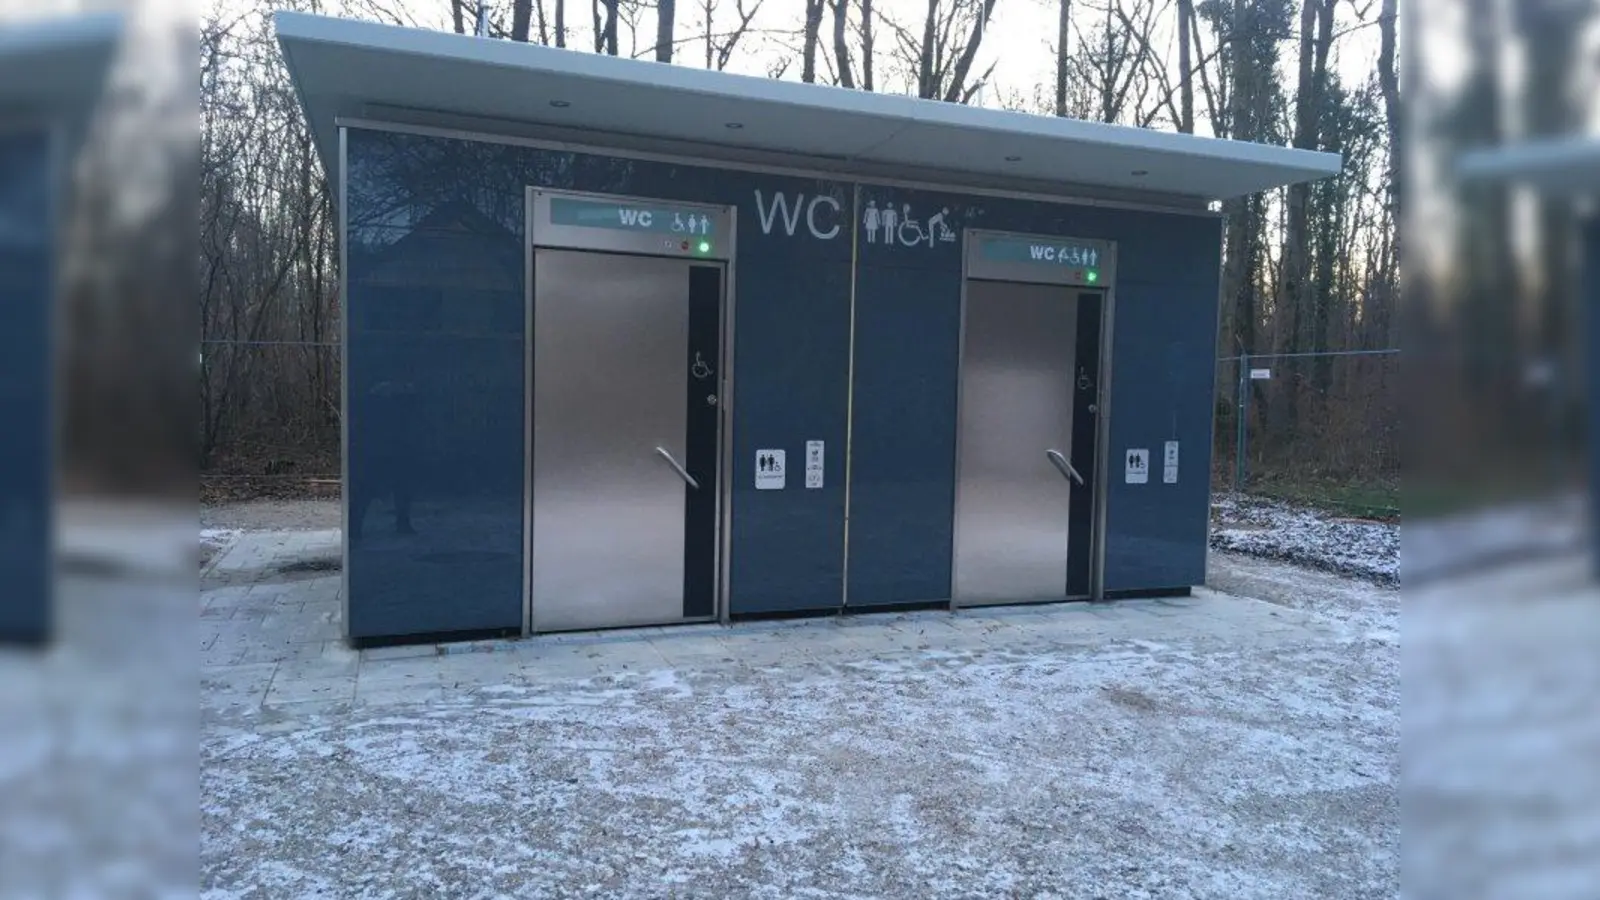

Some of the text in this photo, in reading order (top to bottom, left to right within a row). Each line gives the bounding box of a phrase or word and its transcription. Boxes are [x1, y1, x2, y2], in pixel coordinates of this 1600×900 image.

[619, 209, 652, 227] WC
[754, 189, 840, 240] WC
[1030, 245, 1055, 260] WC
